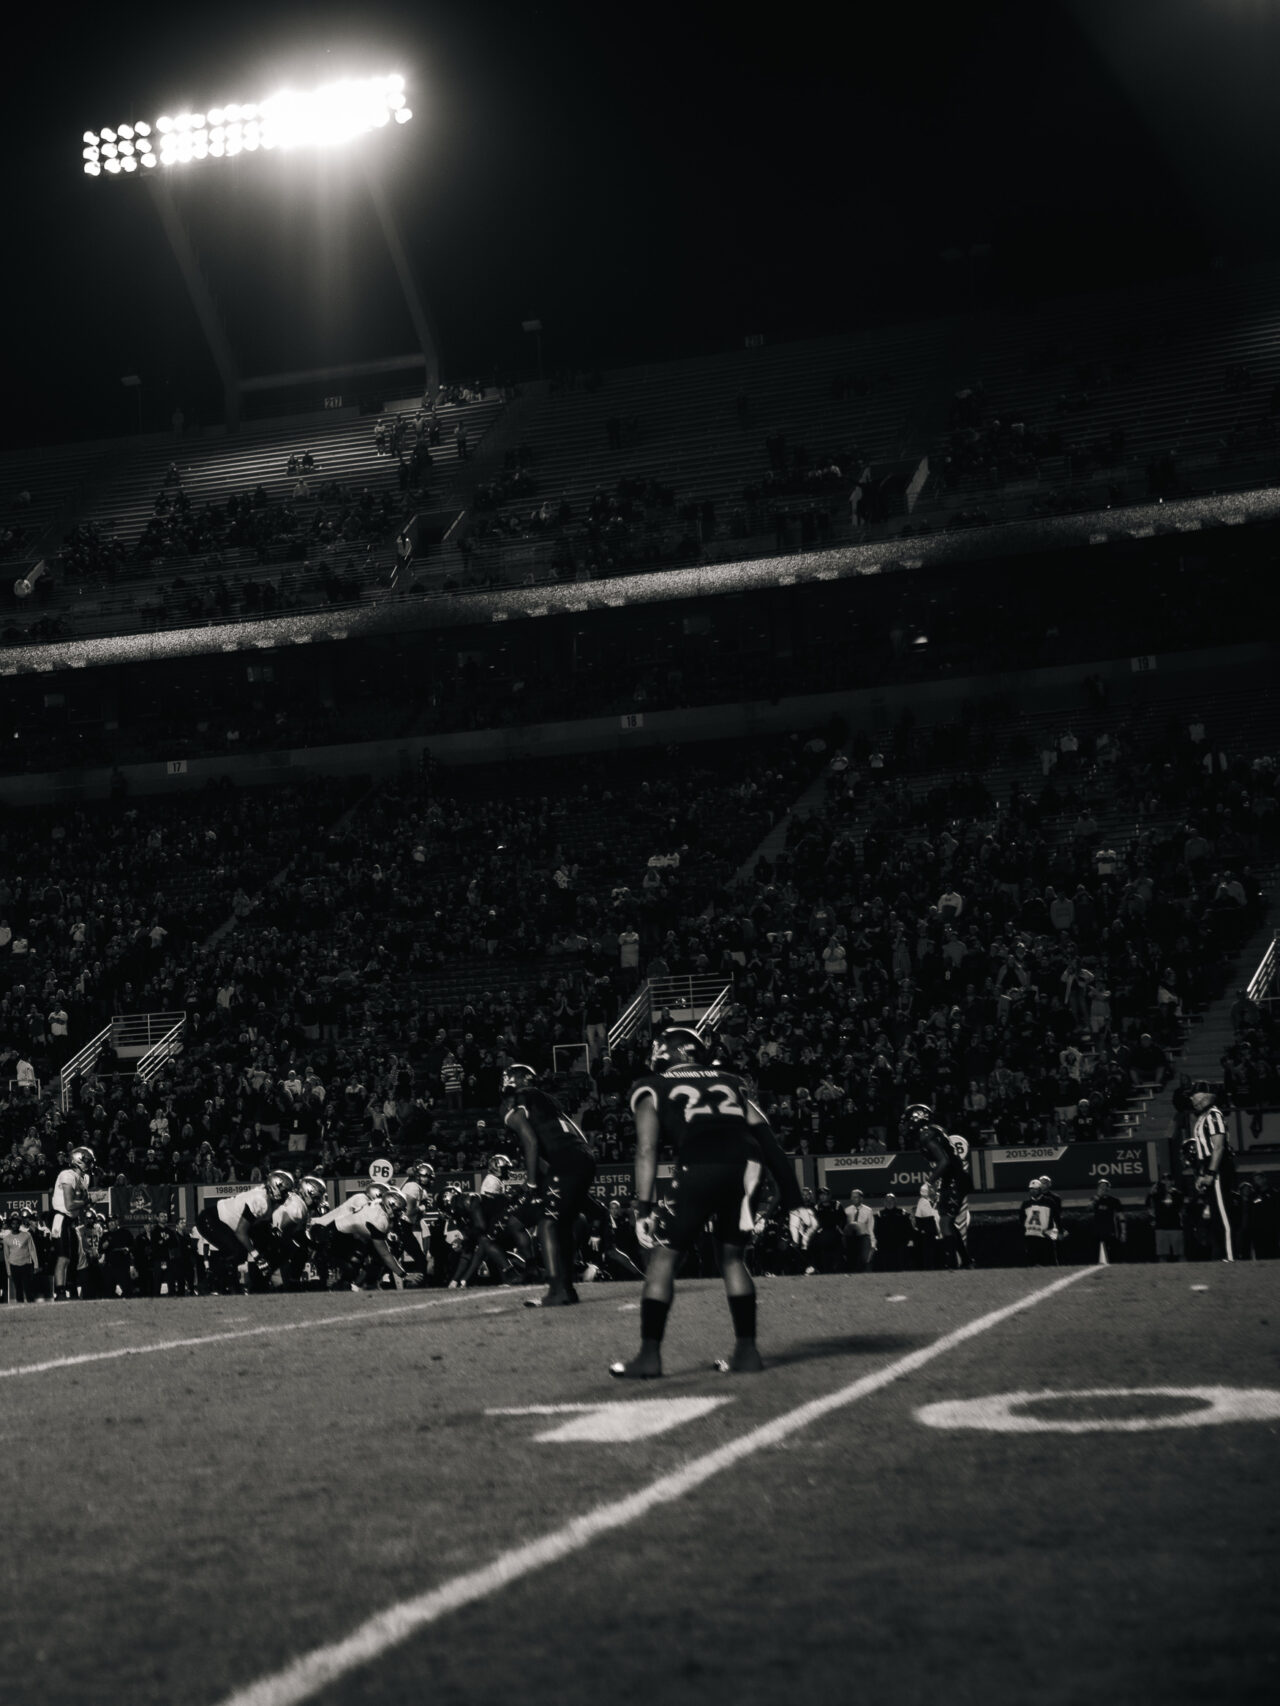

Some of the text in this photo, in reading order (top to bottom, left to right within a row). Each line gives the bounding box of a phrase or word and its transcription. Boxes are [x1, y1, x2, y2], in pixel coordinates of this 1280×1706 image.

[627, 716, 637, 727] 18
[173, 762, 181, 772] 17
[660, 1070, 719, 1078] WASHINGTON
[668, 1084, 746, 1123] 22
[1006, 1148, 1054, 1159] 2013-2016
[1116, 1149, 1142, 1160] ZAY
[834, 1156, 885, 1167] 2004-2007
[372, 1165, 390, 1178] P6
[1088, 1162, 1144, 1176] JONES
[215, 1185, 252, 1195] 1988-1991
[446, 1180, 471, 1190] TOM
[6, 1199, 39, 1210] TERRY
